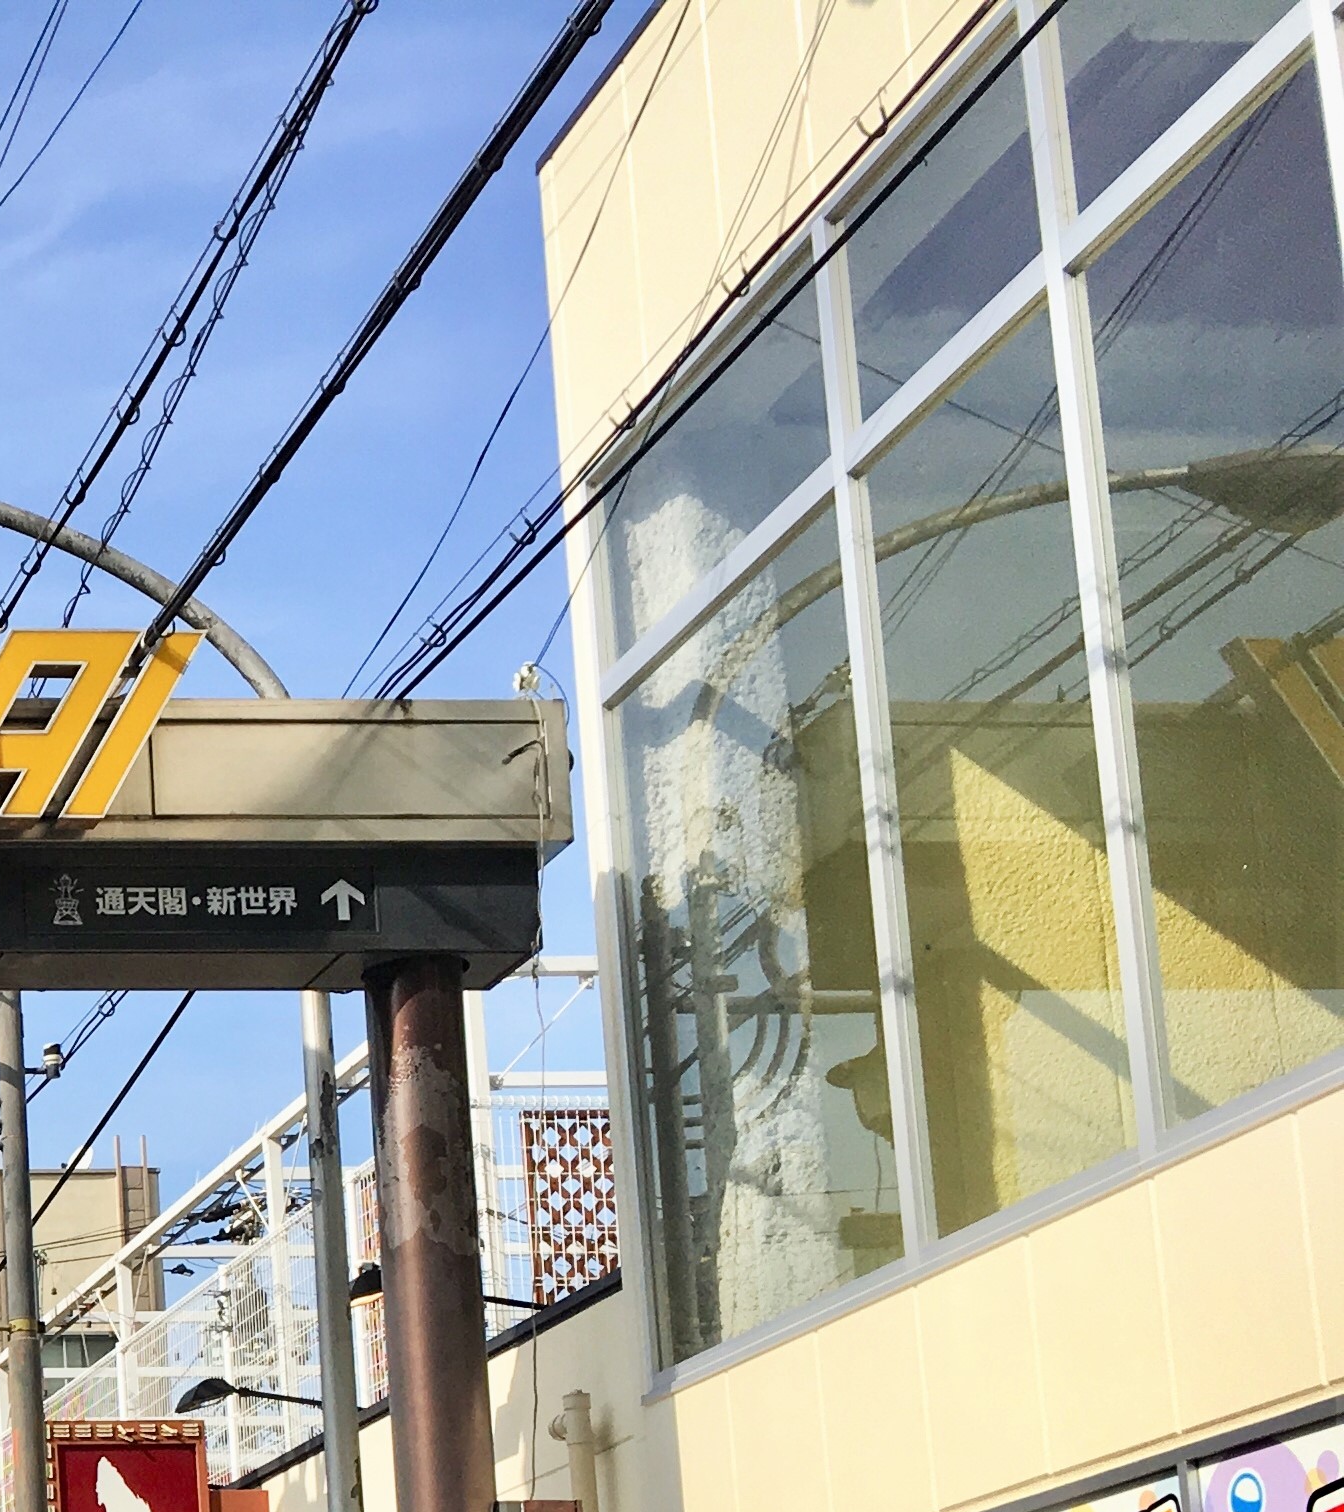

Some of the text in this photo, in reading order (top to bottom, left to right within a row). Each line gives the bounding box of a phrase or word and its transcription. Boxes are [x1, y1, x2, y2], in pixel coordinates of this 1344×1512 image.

[95, 886, 299, 917] 通天閣・新世界
